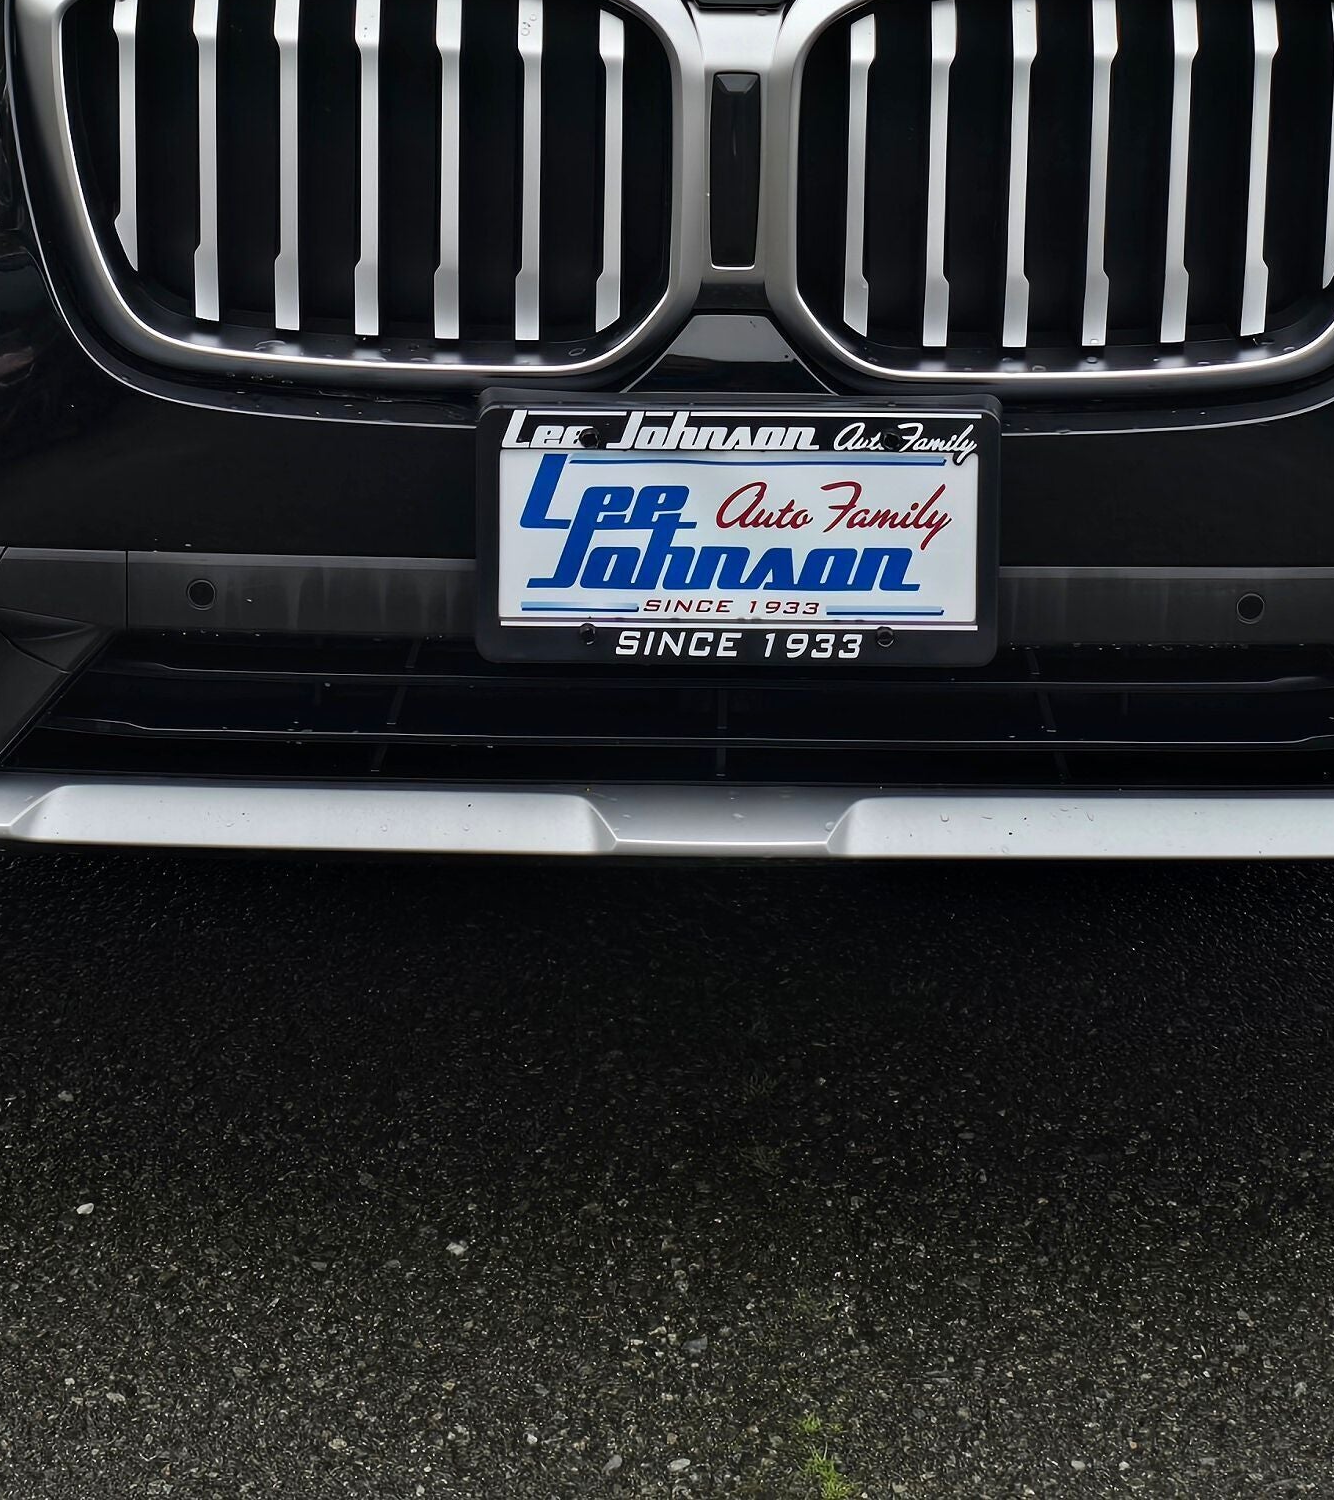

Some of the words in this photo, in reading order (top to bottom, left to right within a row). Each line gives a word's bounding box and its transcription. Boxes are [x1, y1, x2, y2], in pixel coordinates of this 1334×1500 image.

[501, 409, 597, 449] Lee
[605, 410, 820, 450] Johnson
[833, 422, 885, 451] Aut
[897, 422, 978, 465] Family
[519, 453, 698, 530] Lee
[715, 481, 814, 530] Auto
[820, 480, 953, 551] Family
[526, 524, 921, 592] Johnson
[642, 599, 734, 614] SINCE
[749, 600, 820, 615] 1933
[614, 629, 744, 658] SINCE
[764, 632, 864, 659] 1933
